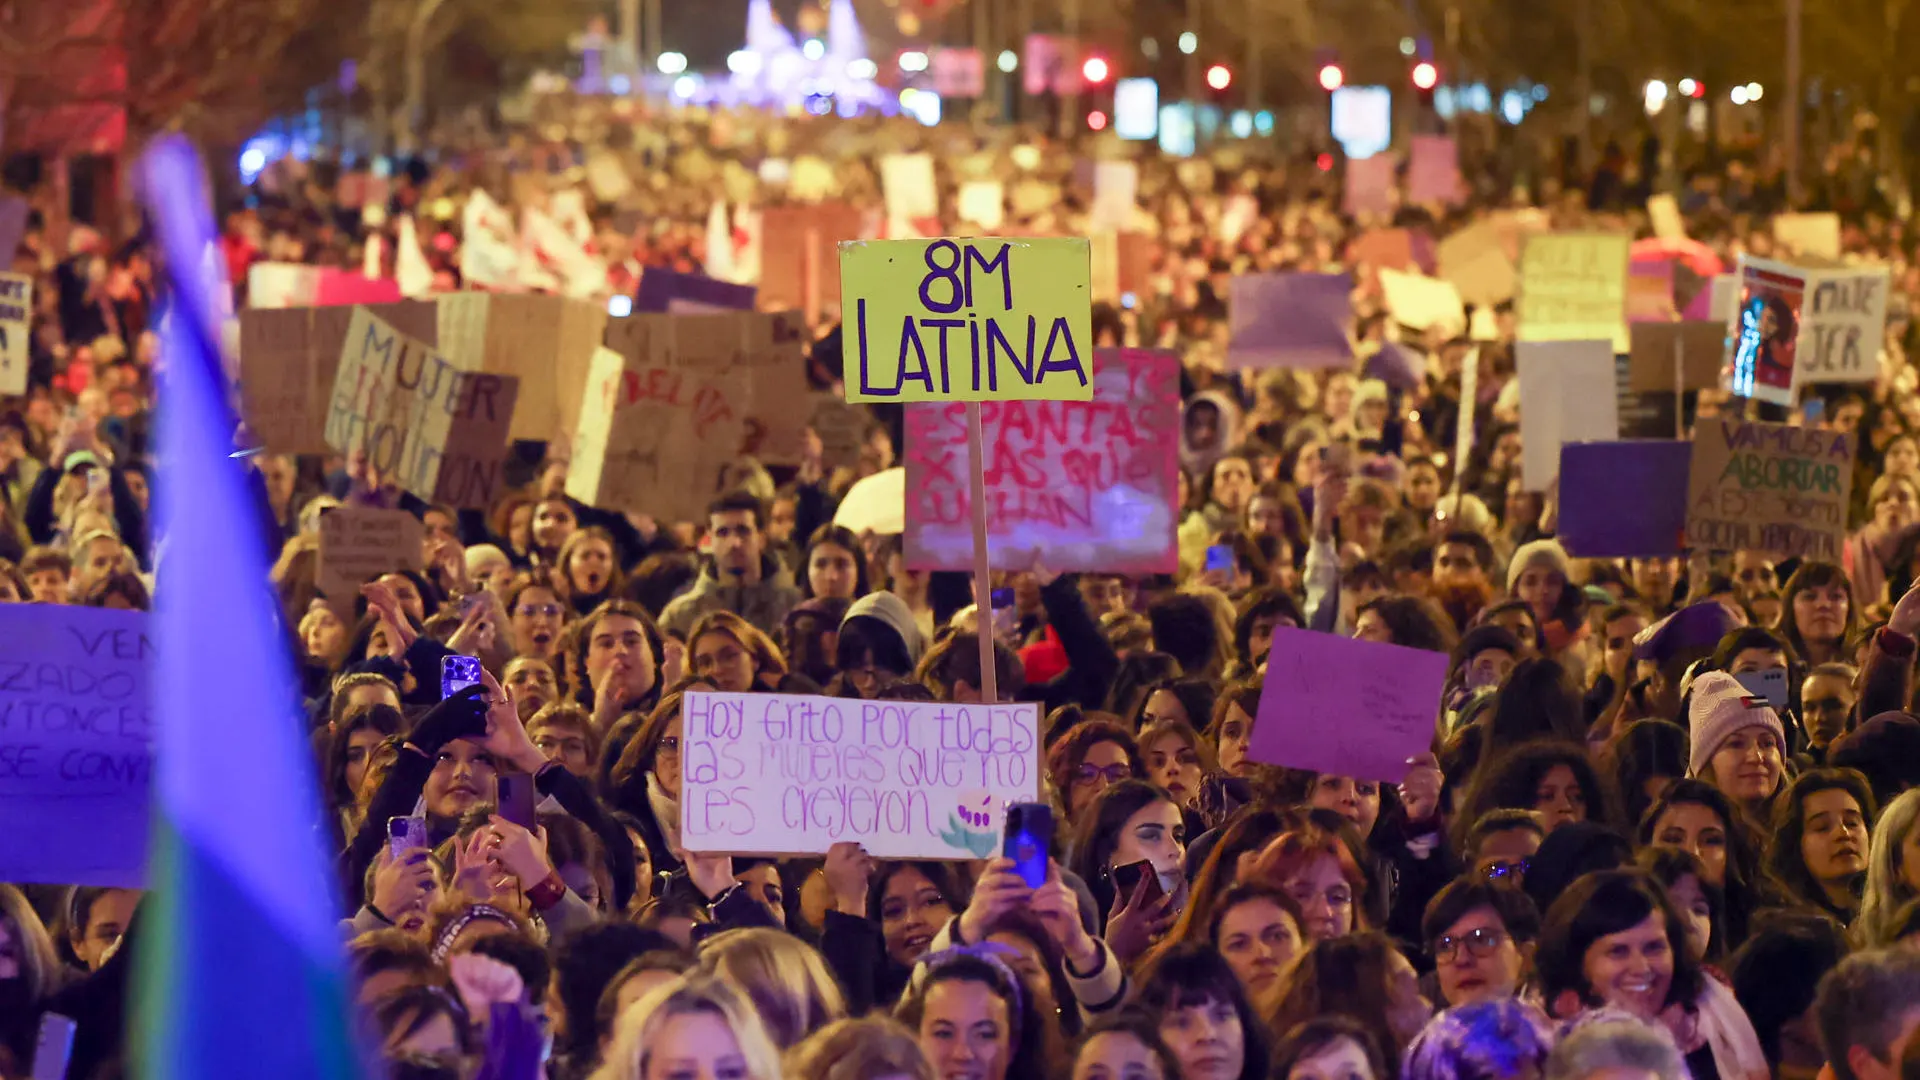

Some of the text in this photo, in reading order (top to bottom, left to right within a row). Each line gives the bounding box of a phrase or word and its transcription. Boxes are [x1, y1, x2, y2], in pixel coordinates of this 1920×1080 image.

[918, 239, 1012, 313] 8M
[361, 323, 501, 422] MUJER
[1721, 420, 1850, 461] VAMOS A
[921, 450, 955, 491] X
[1718, 450, 1843, 496] ABORTAR
[911, 488, 1092, 530] LUHAN
[688, 695, 744, 740] Hoy
[758, 699, 844, 744] Grito
[933, 707, 1033, 754] todas
[685, 740, 1026, 788] Las mujeres Que no
[686, 784, 940, 838] Les creyeron
